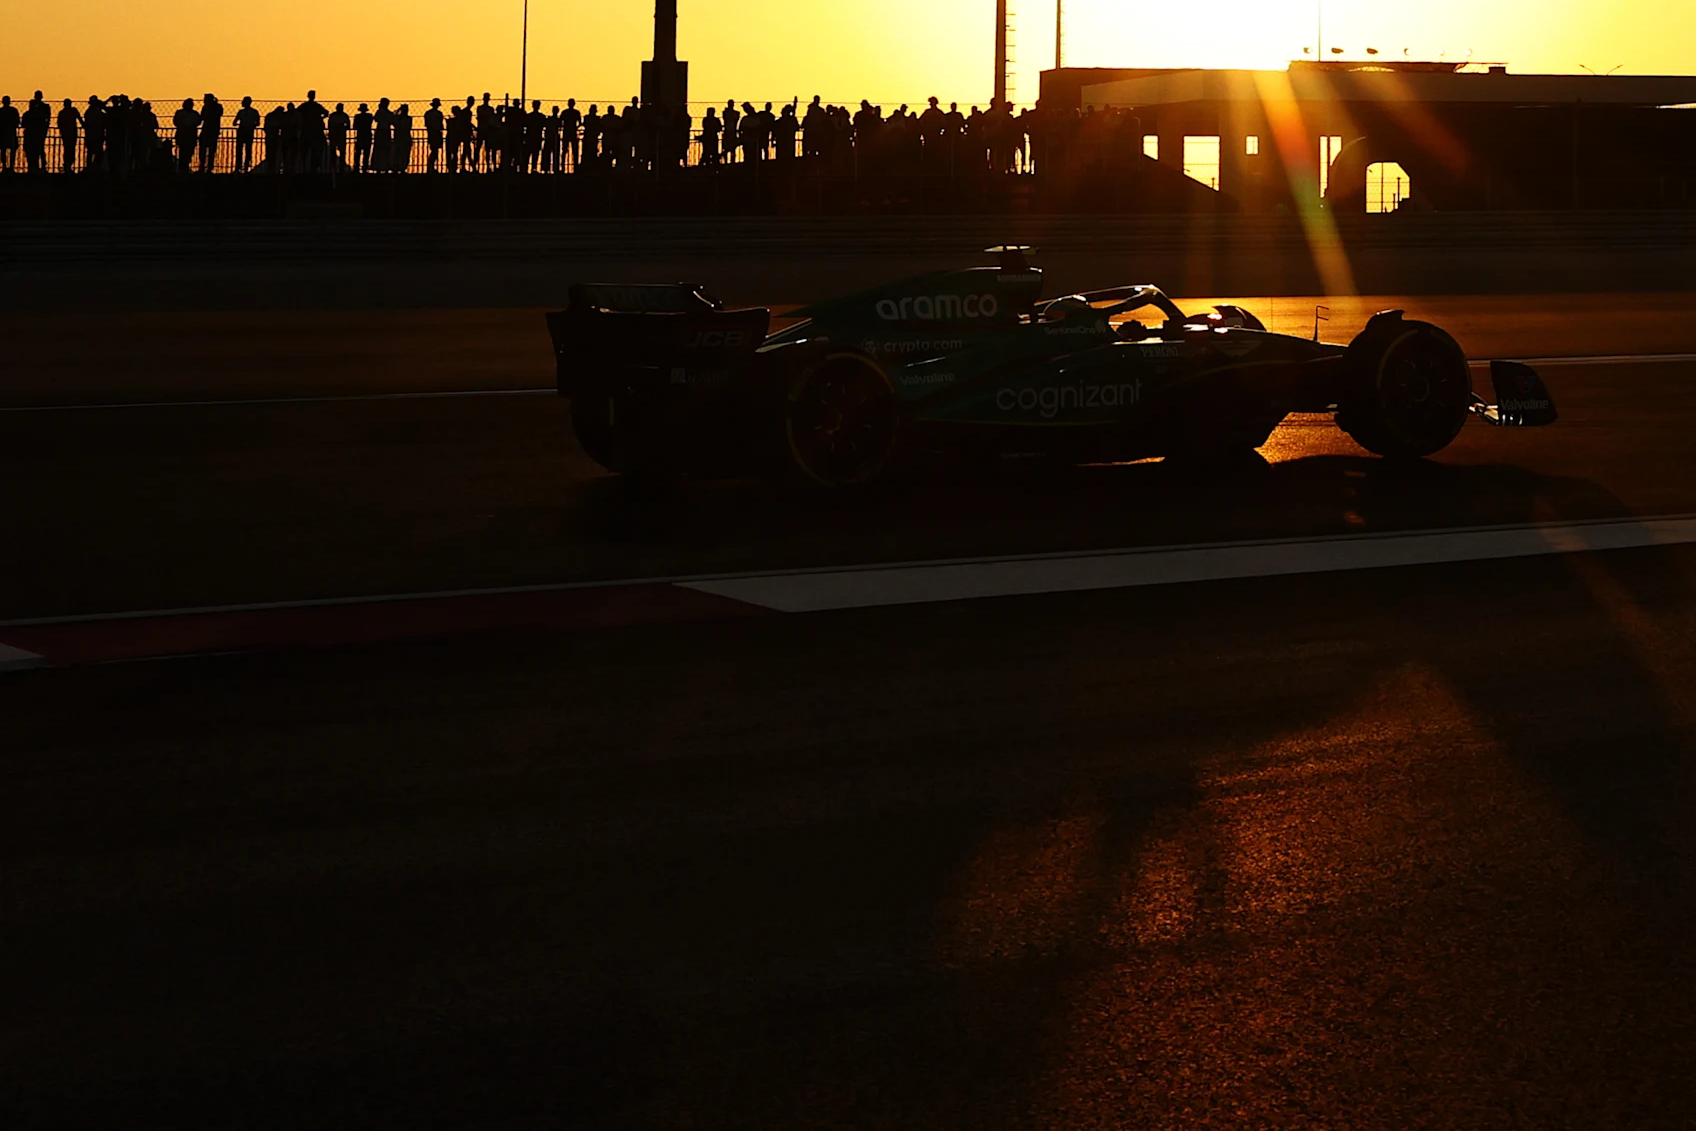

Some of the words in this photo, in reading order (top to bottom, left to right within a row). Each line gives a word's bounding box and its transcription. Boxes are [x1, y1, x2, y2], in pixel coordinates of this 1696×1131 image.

[875, 293, 999, 320] aramco
[685, 330, 745, 348] JCB
[900, 371, 956, 387] Valvoline
[996, 378, 1144, 418] cognizant
[1500, 399, 1549, 411] Valvoline
